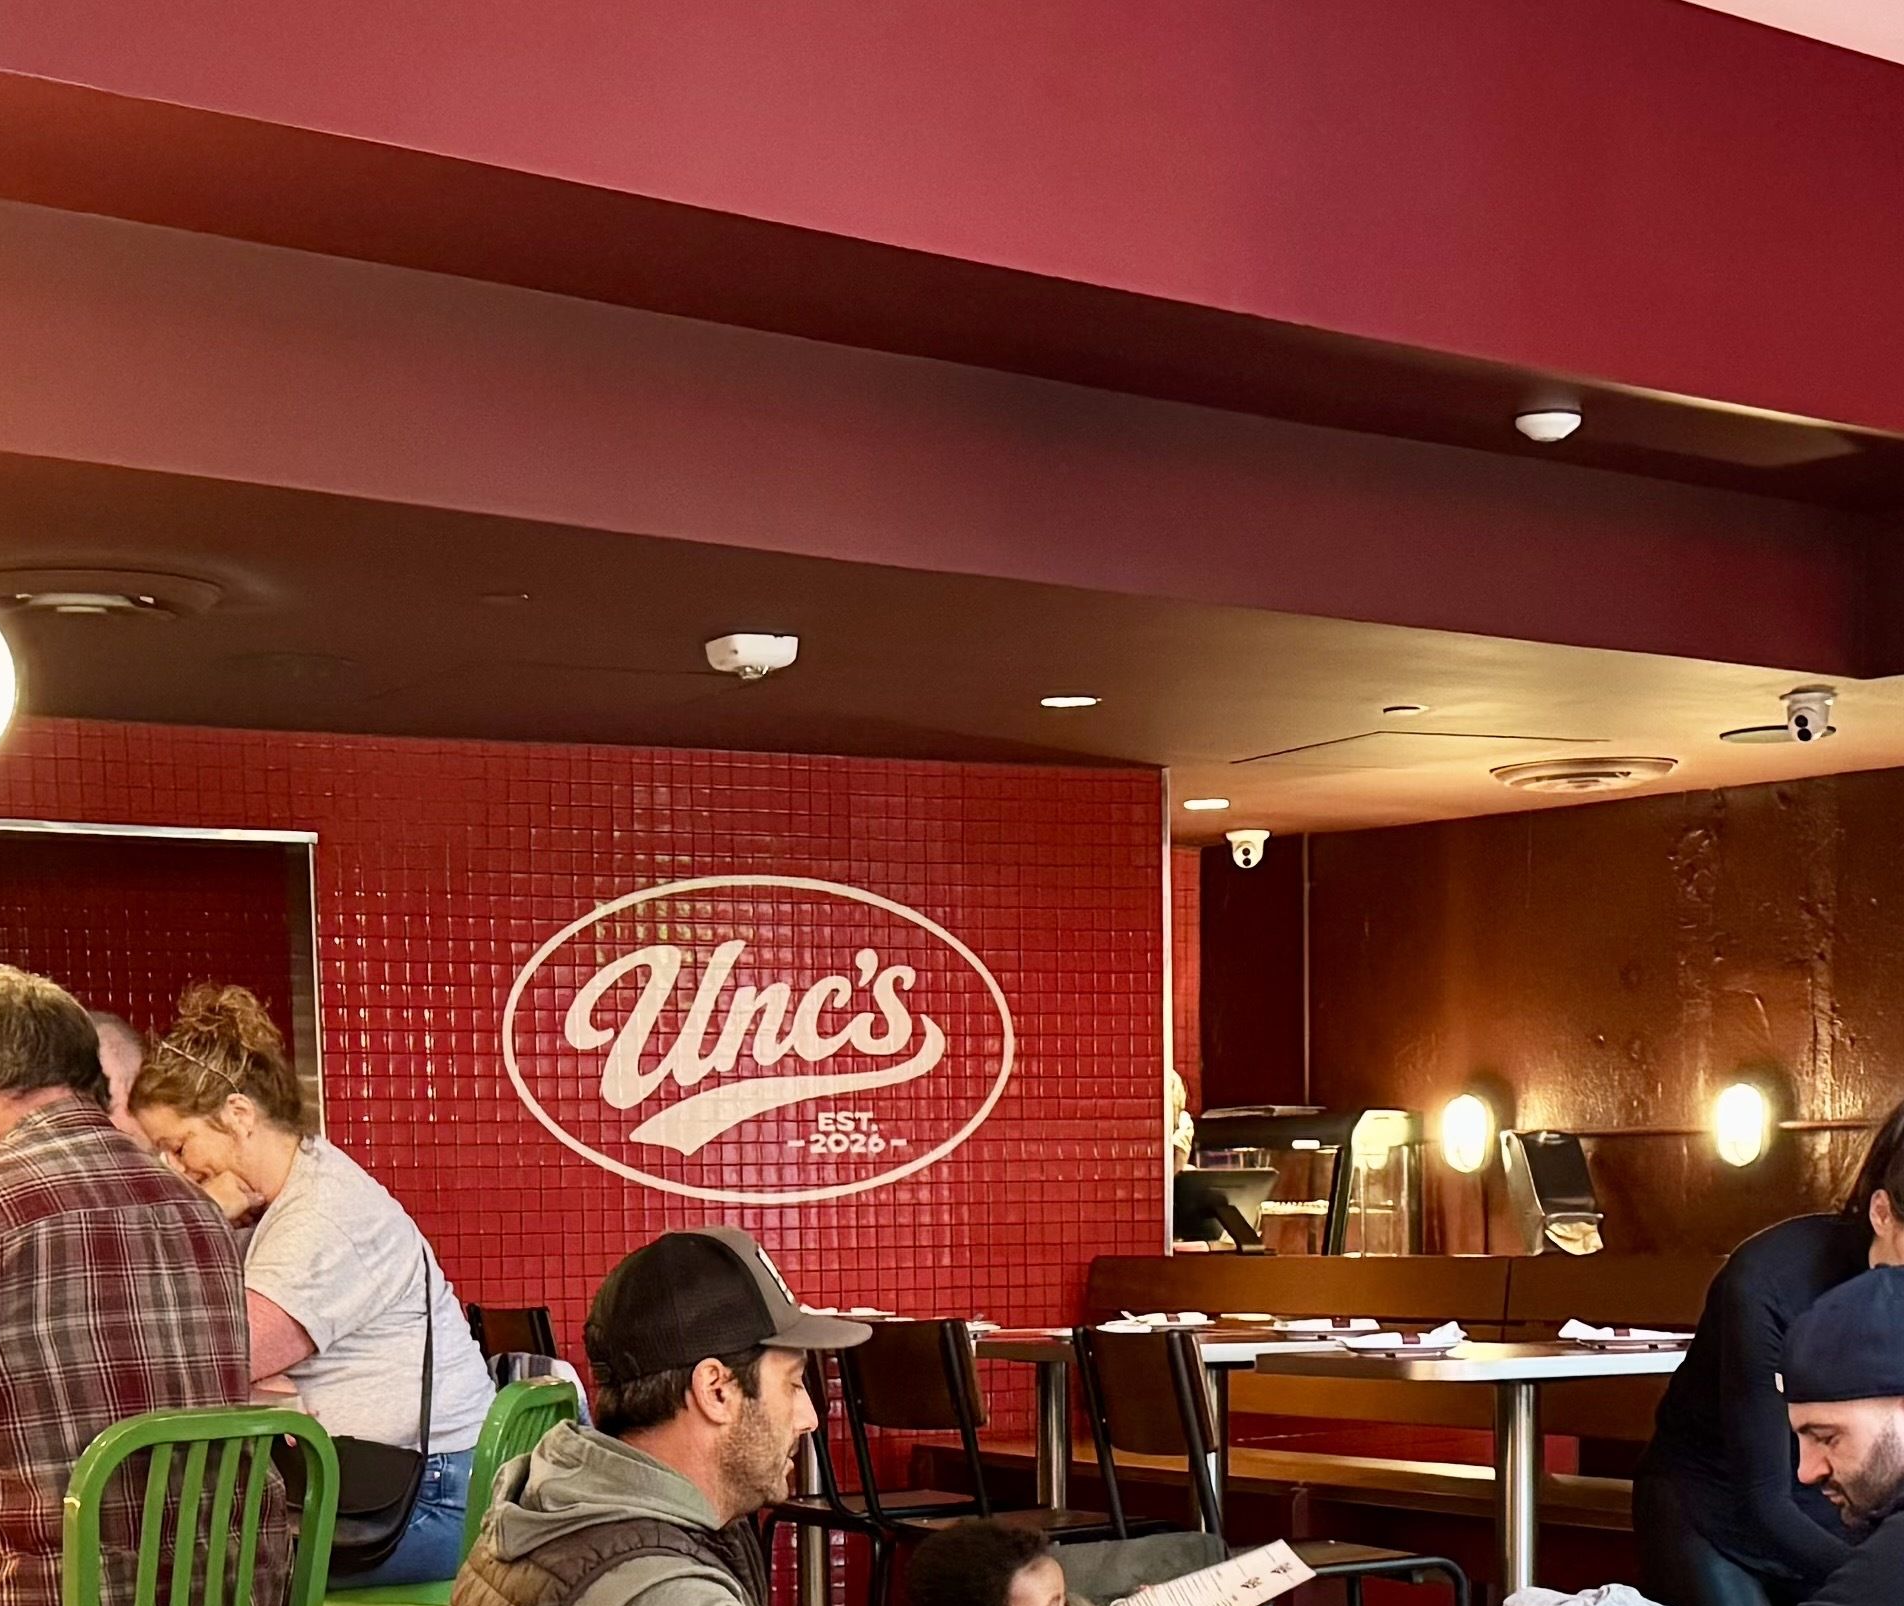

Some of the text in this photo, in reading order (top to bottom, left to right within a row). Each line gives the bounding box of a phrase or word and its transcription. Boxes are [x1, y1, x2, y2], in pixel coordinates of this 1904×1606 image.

[564, 939, 917, 1110] Unc's
[817, 1111, 879, 1133] EST.
[809, 1133, 886, 1155] 2026
